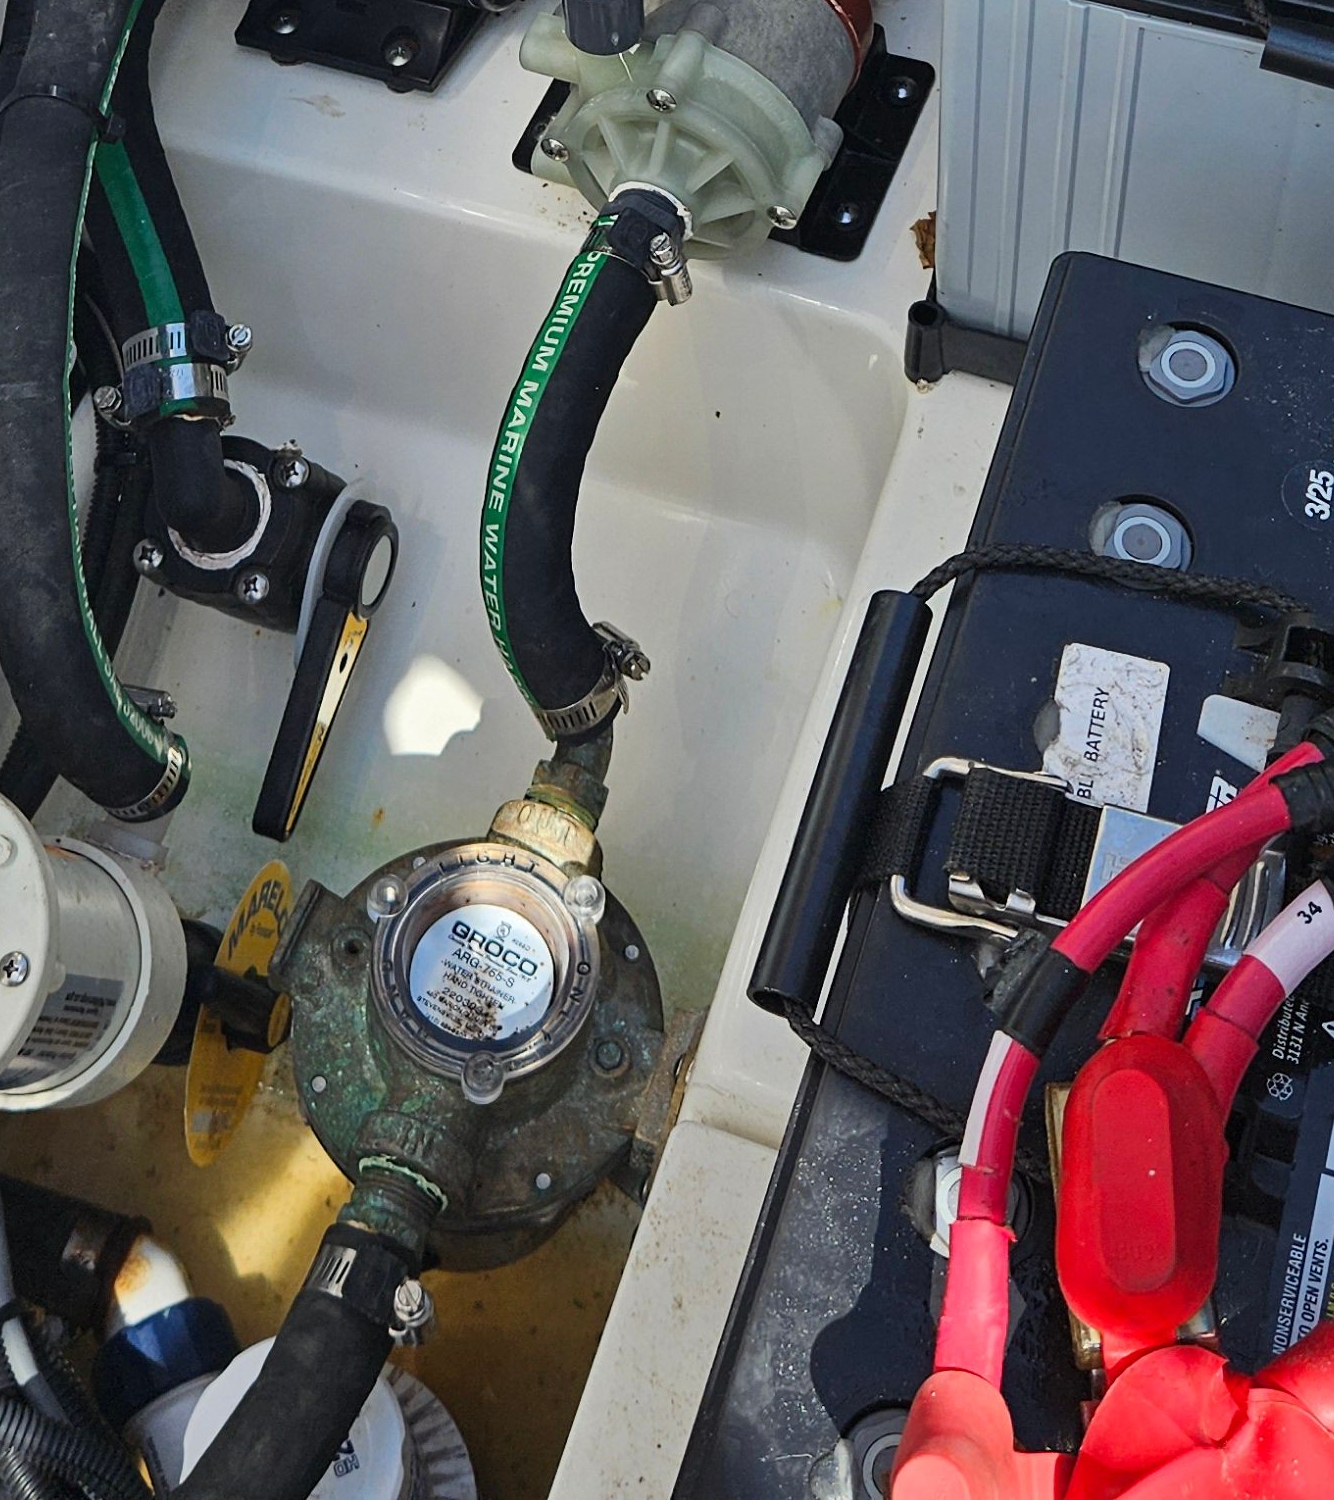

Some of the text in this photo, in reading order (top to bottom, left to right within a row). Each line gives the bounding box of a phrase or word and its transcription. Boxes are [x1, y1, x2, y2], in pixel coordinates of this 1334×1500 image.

[476, 249, 603, 631] PREMIUM MARINE WATER
[1303, 468, 1334, 522] 3/25
[1083, 686, 1110, 762] BATTERY
[1295, 898, 1325, 926] 34
[450, 920, 539, 978] GROCO
[451, 946, 515, 989] ARG-765-S
[443, 971, 467, 989] HAND
[1285, 1033, 1303, 1064] 3131
[1272, 1234, 1312, 1355] NONSERVICEABLE
[1298, 1235, 1330, 1322] OPEN VENTS.
